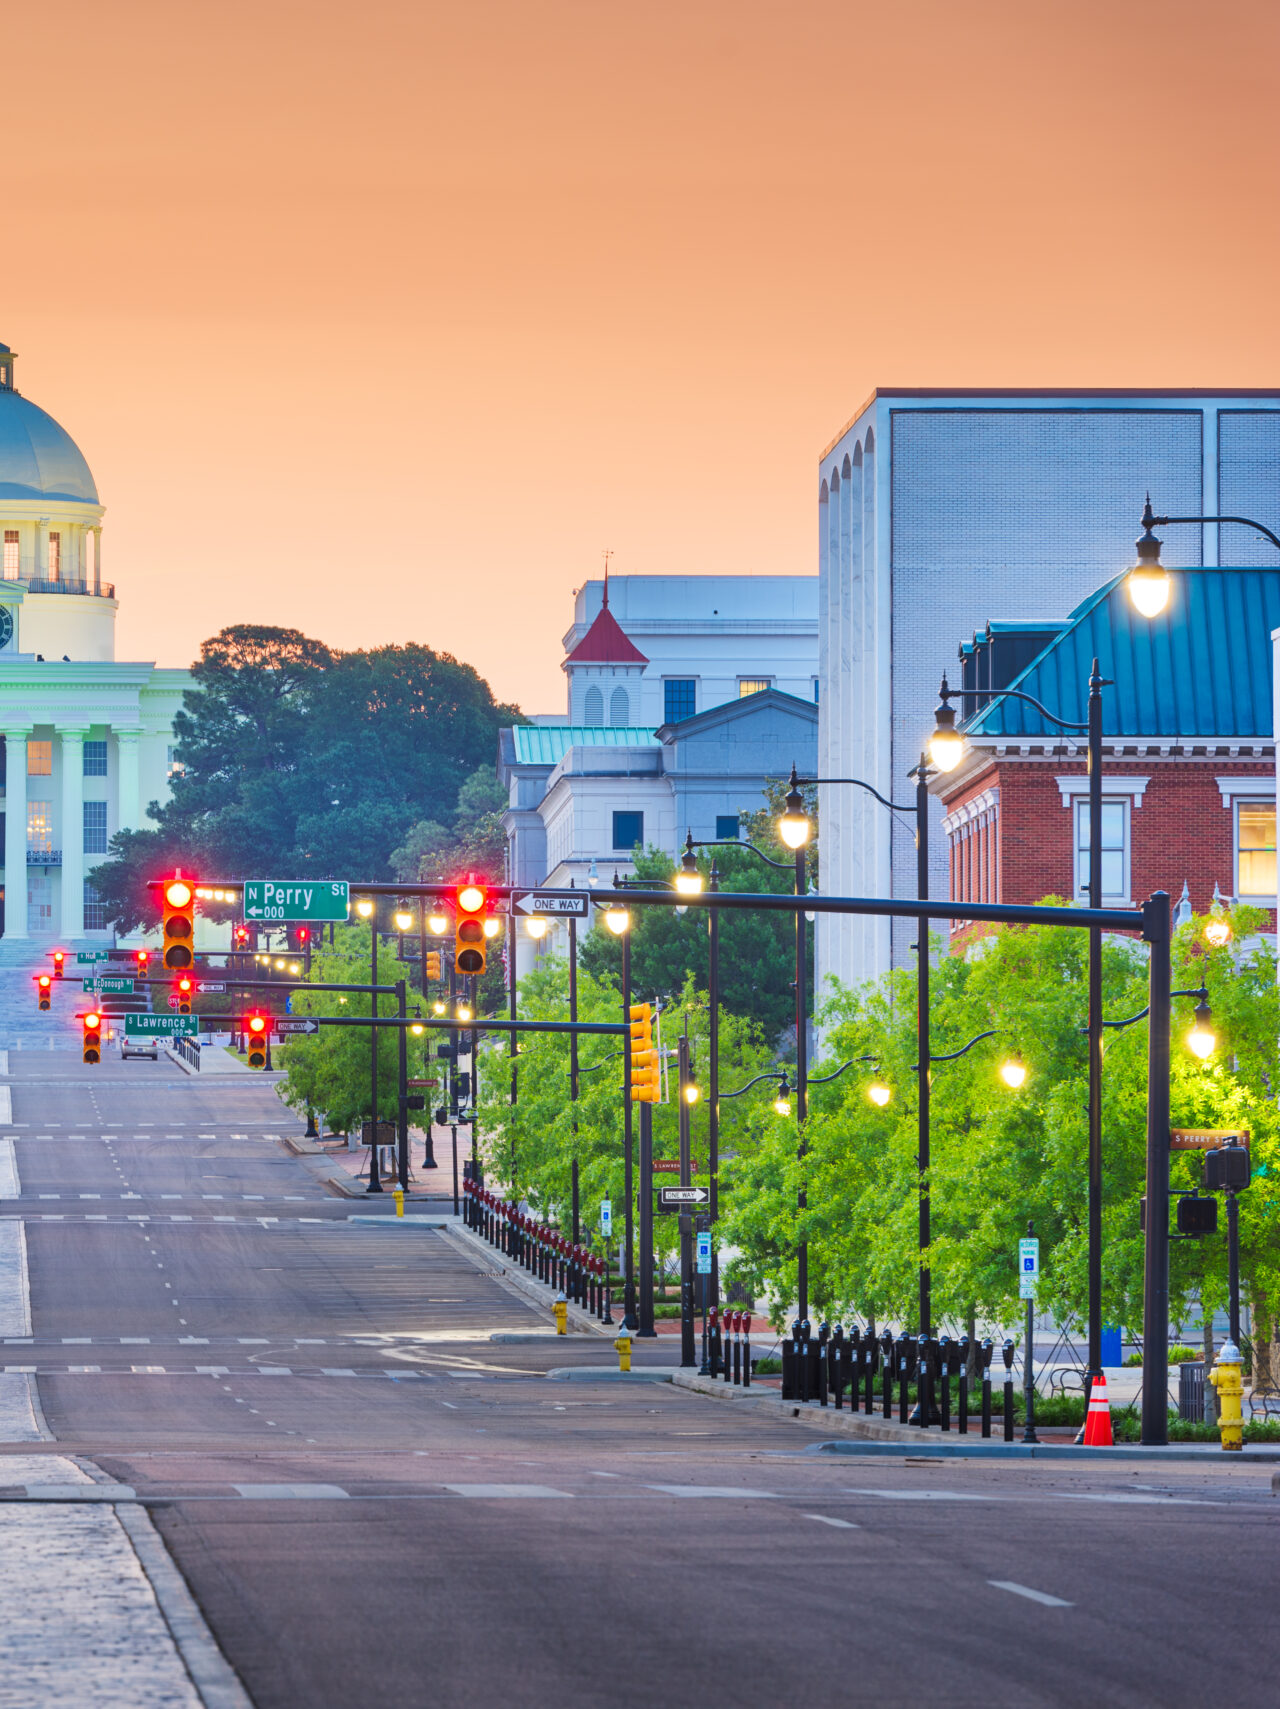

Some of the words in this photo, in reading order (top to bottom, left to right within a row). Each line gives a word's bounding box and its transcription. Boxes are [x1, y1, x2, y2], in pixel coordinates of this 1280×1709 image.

[248, 887, 258, 900] N
[263, 883, 313, 911] Perry
[331, 883, 345, 896] St
[534, 899, 556, 910] ONE
[558, 899, 580, 910] WAY
[263, 905, 285, 918] 000
[128, 1016, 133, 1025] S
[137, 1015, 186, 1028] Lawrence
[1175, 1134, 1181, 1142] S
[1184, 1135, 1210, 1143] PERRY
